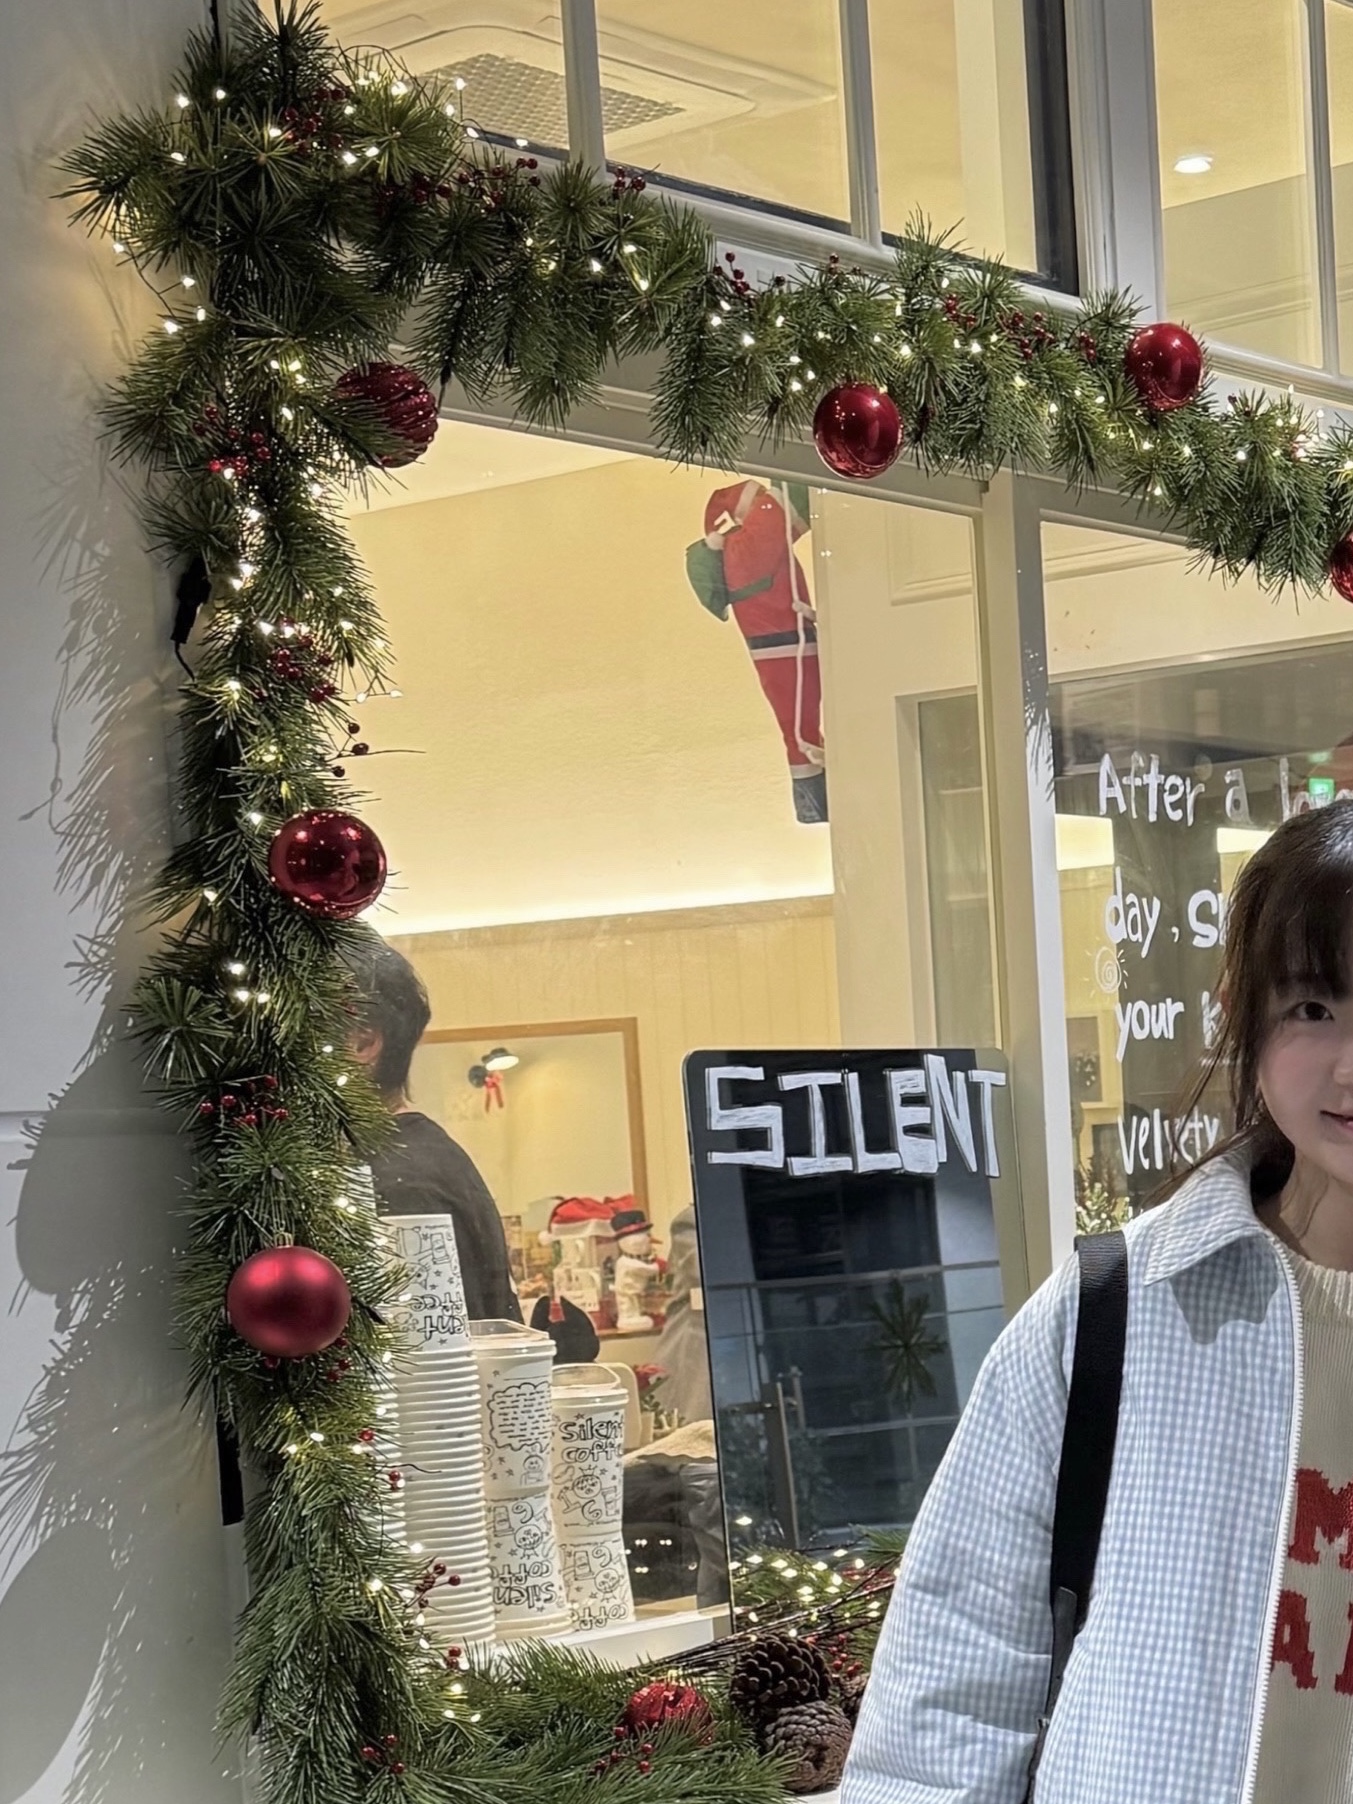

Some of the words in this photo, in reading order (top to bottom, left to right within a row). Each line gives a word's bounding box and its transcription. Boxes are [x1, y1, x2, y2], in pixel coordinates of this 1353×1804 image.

[1099, 751, 1205, 827] After
[1225, 768, 1252, 824] a
[1115, 997, 1184, 1064] your
[703, 1055, 1007, 1178] SILENT
